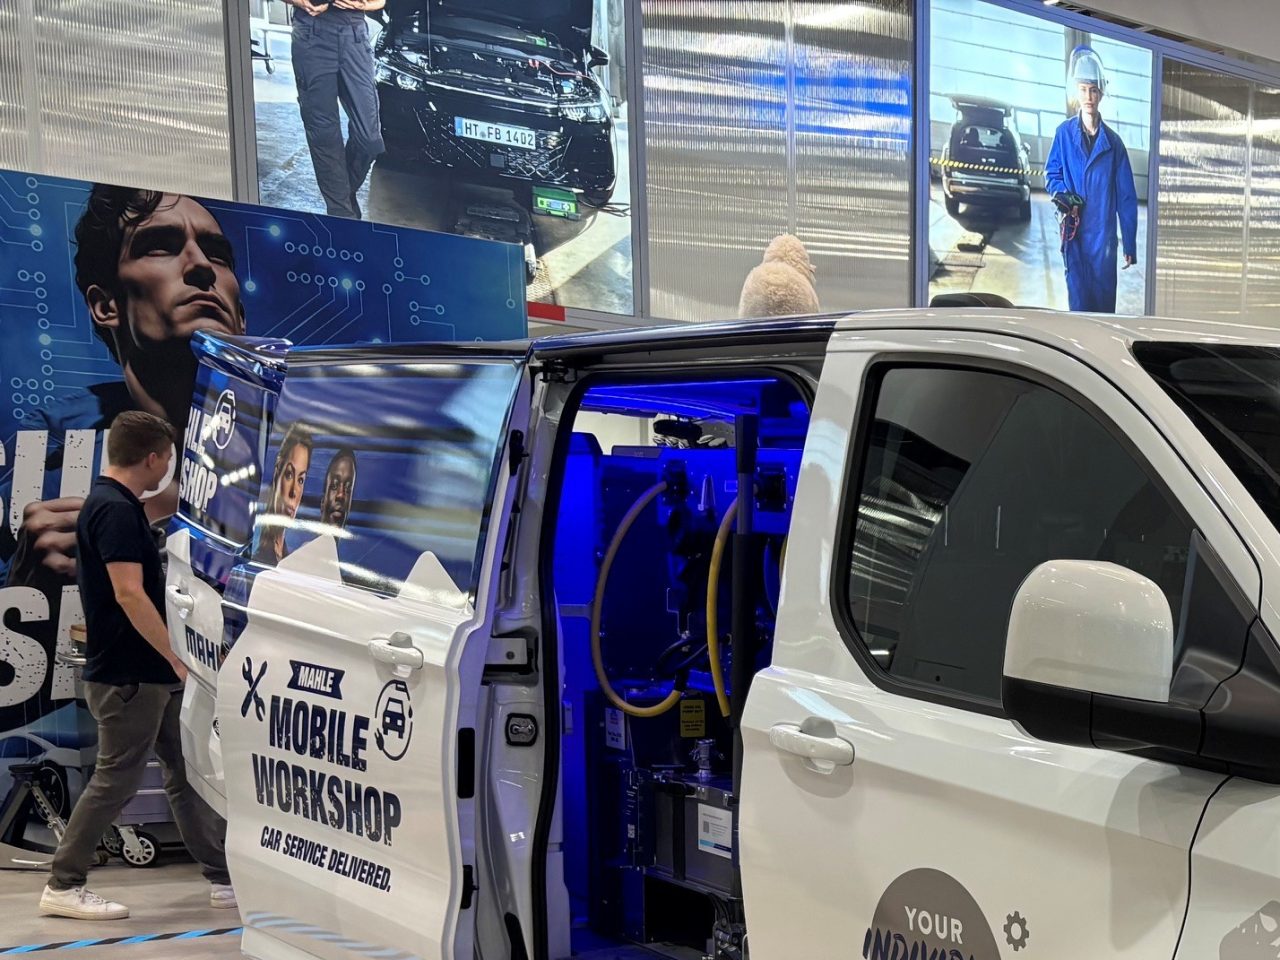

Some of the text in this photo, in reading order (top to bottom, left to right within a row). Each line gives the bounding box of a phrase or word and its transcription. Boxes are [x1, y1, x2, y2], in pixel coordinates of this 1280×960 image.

[465, 122, 534, 147] HT FB 1402
[299, 665, 335, 693] MAHLE
[269, 694, 371, 773] MOBILE
[252, 752, 403, 847] WORKSHOP
[260, 825, 392, 893] CAR SERVICE DELIVERED.
[904, 905, 963, 944] YOUR
